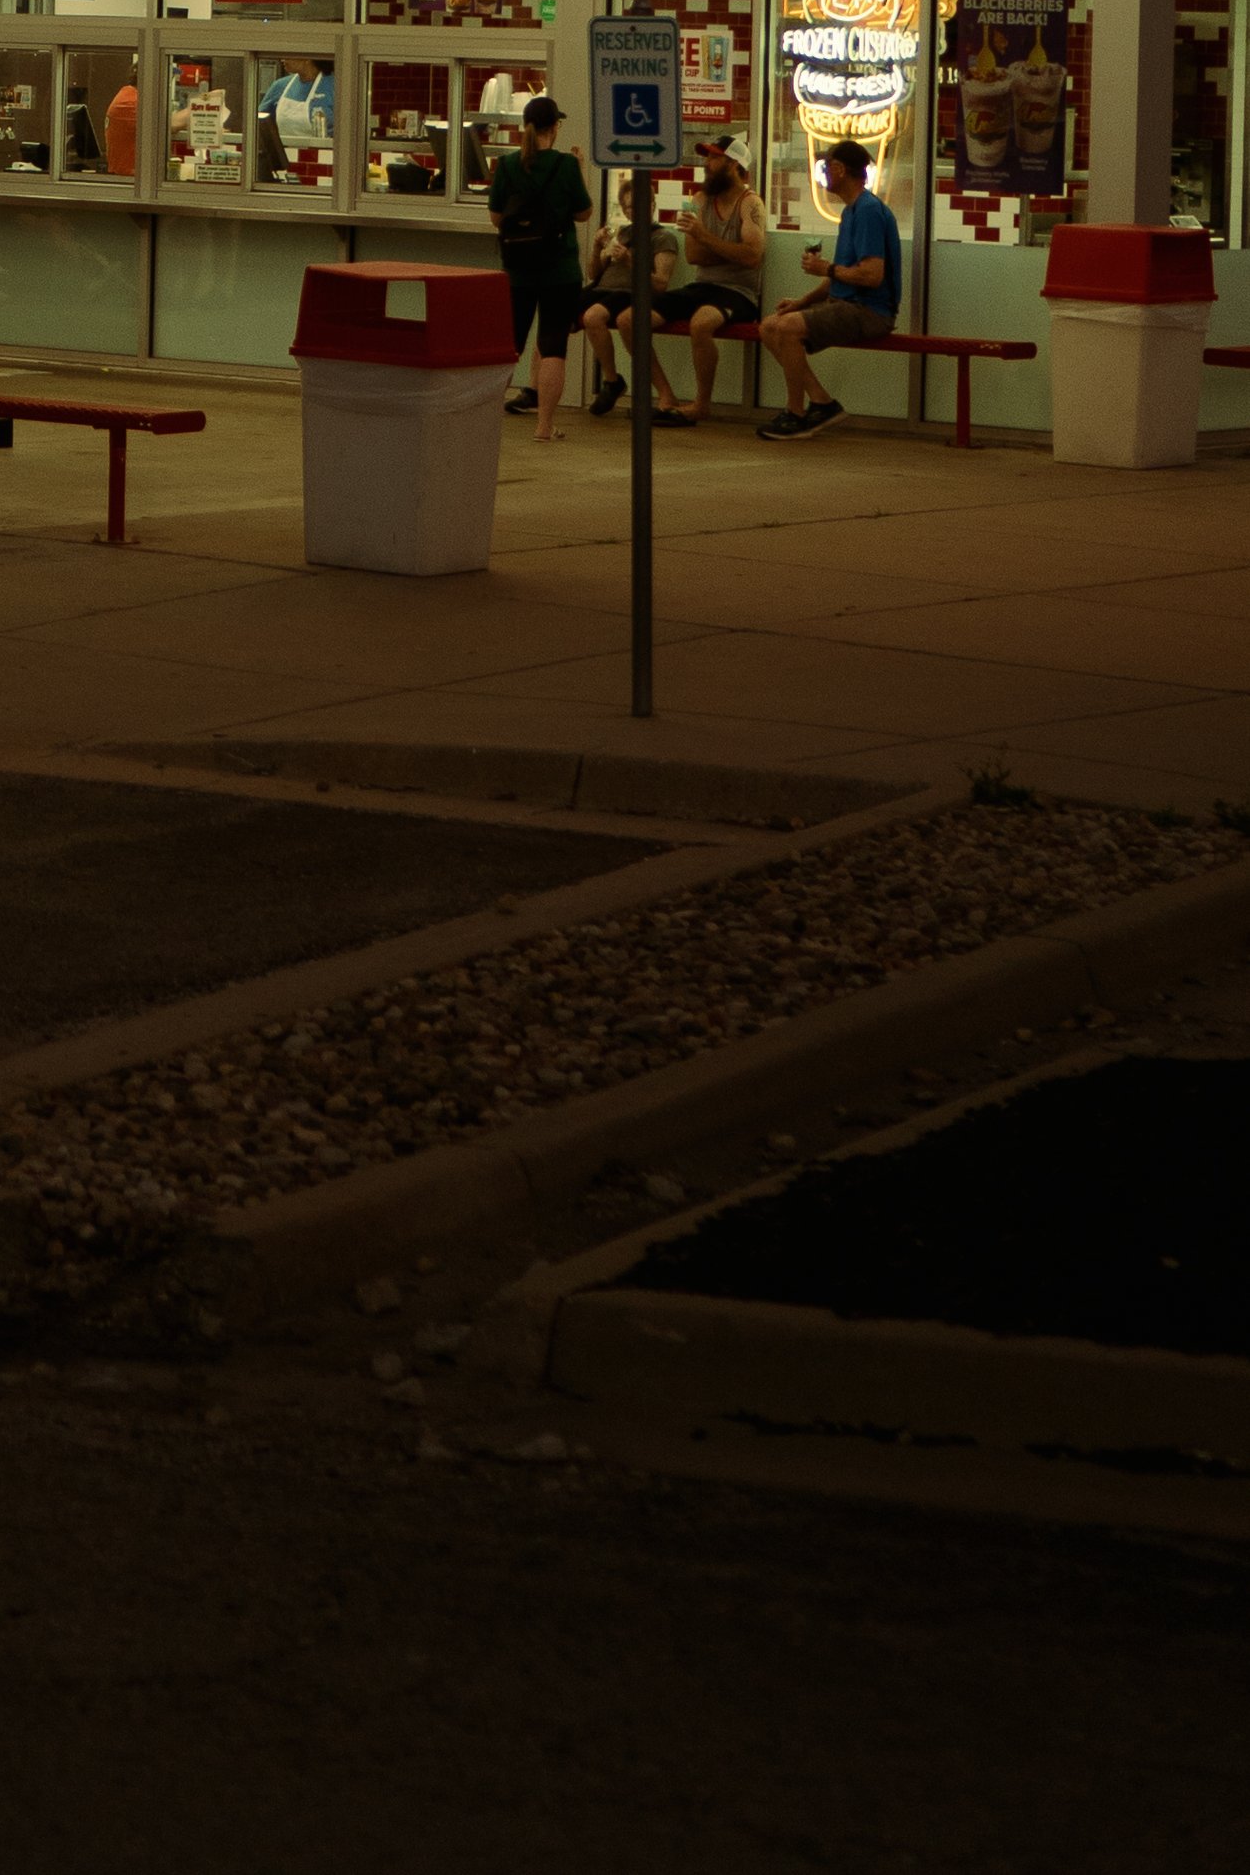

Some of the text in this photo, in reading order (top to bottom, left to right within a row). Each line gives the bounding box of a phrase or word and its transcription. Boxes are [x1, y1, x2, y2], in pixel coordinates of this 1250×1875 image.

[977, 11, 1048, 26] ARE BACK!
[596, 32, 672, 51] RESERVED
[783, 27, 846, 61] FROZEN
[601, 57, 668, 76] PARKING
[799, 69, 846, 96] MADE
[847, 71, 897, 97] FRESH
[694, 105, 725, 115] POINTS
[805, 110, 891, 135] EVERY HOUR
